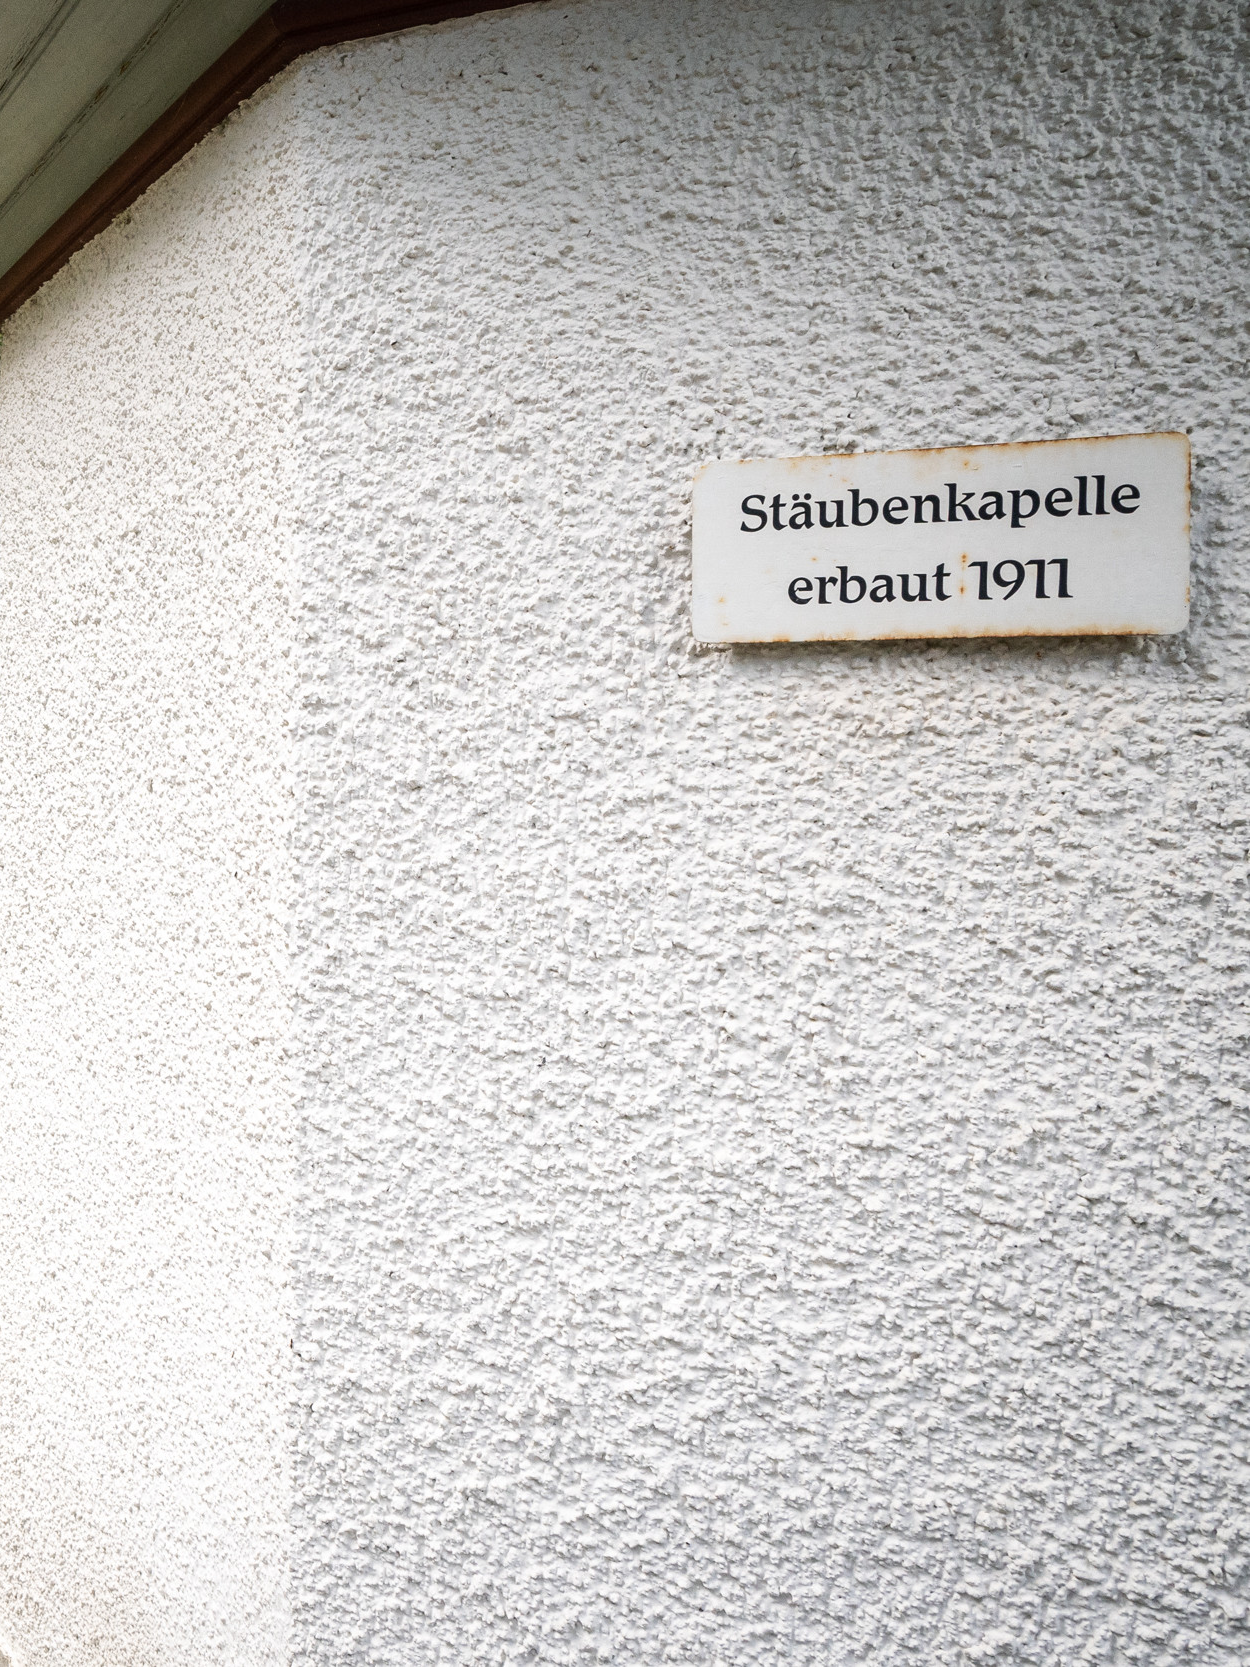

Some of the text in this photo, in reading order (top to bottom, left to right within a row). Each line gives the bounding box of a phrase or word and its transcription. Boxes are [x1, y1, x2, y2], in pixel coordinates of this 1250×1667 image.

[740, 474, 1141, 533] Stäubenkapelle
[787, 558, 1074, 605] erbaut 1911
